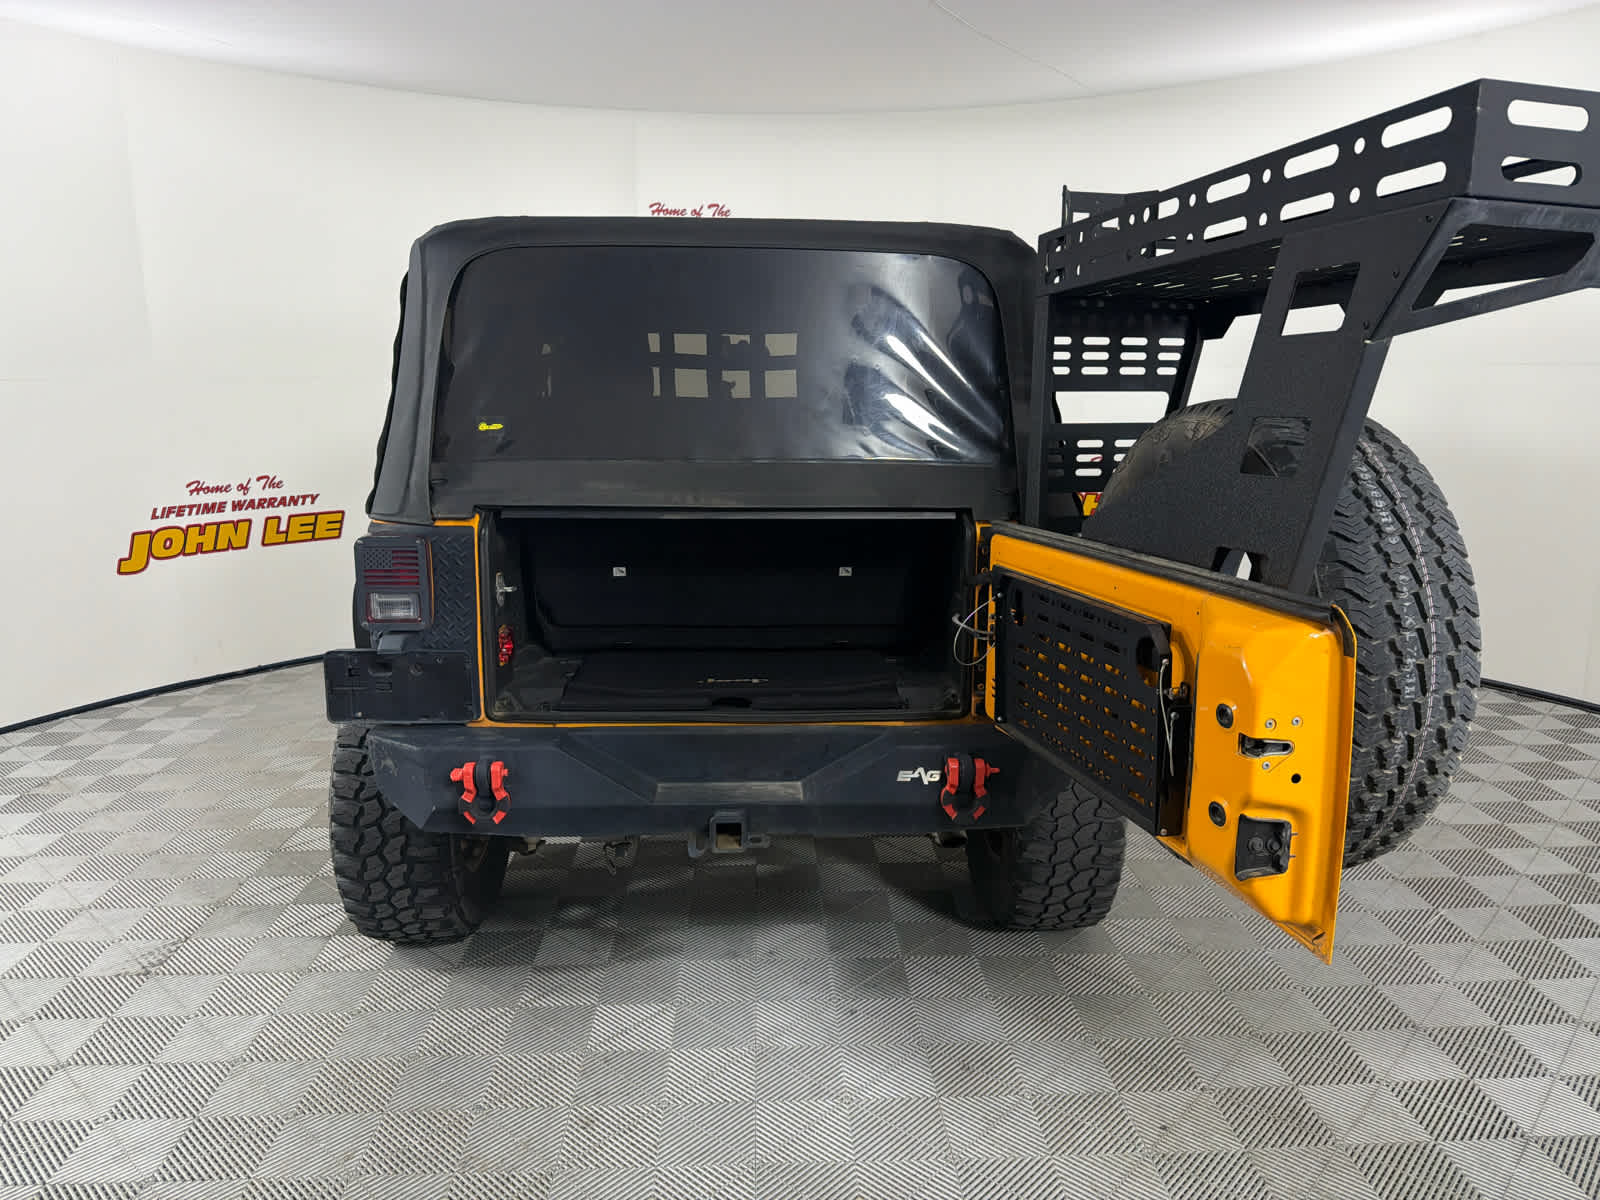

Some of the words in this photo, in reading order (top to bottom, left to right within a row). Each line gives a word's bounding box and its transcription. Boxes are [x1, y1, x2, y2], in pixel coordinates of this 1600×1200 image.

[649, 202, 687, 216] Home
[690, 204, 704, 217] of
[707, 203, 731, 217] The
[185, 480, 232, 496] Home
[236, 477, 251, 495] of
[256, 475, 284, 491] The
[150, 500, 228, 520] LIFETIME
[231, 493, 320, 512] WARRANTY
[117, 519, 252, 576] JOHN
[261, 510, 345, 547] LEE
[896, 767, 942, 785] EAG
